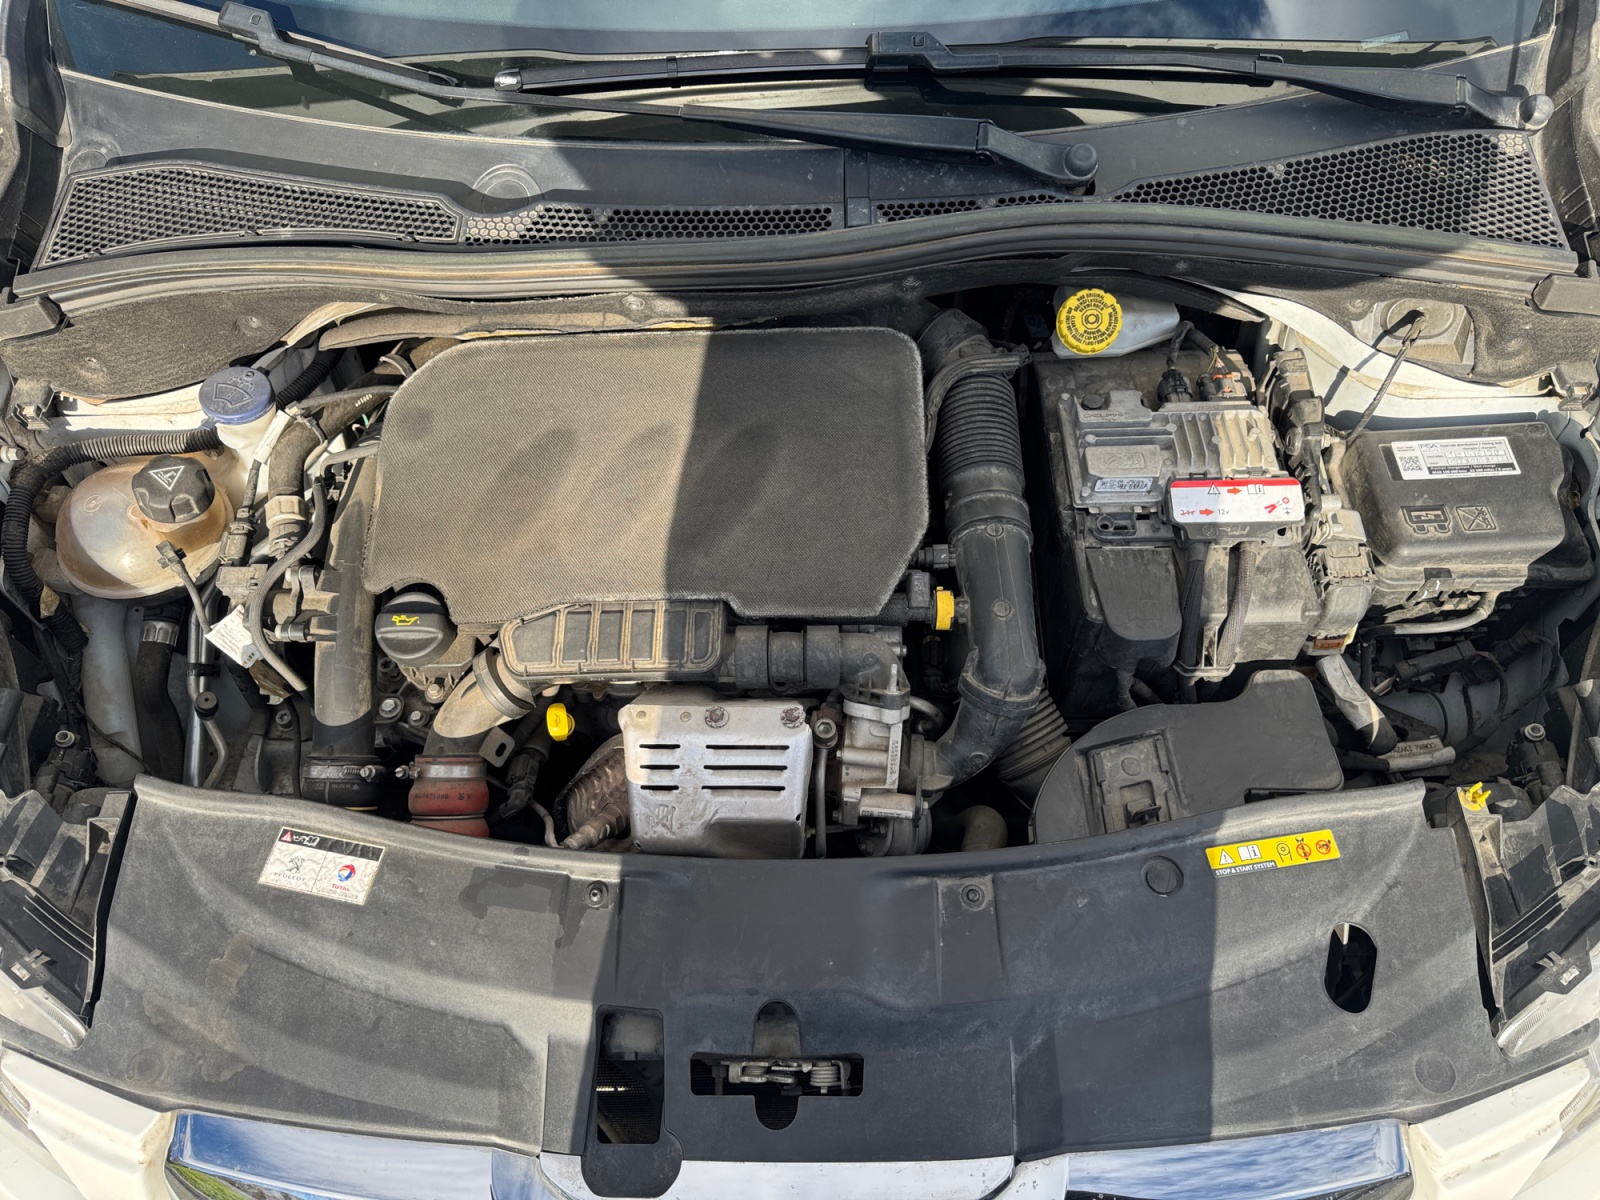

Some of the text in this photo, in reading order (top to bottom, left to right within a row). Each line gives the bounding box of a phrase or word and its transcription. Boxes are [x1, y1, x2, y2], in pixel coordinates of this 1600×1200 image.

[1072, 327, 1084, 338] FILLER
[274, 872, 306, 882] PEUGEOT
[332, 883, 350, 891] TOTAL
